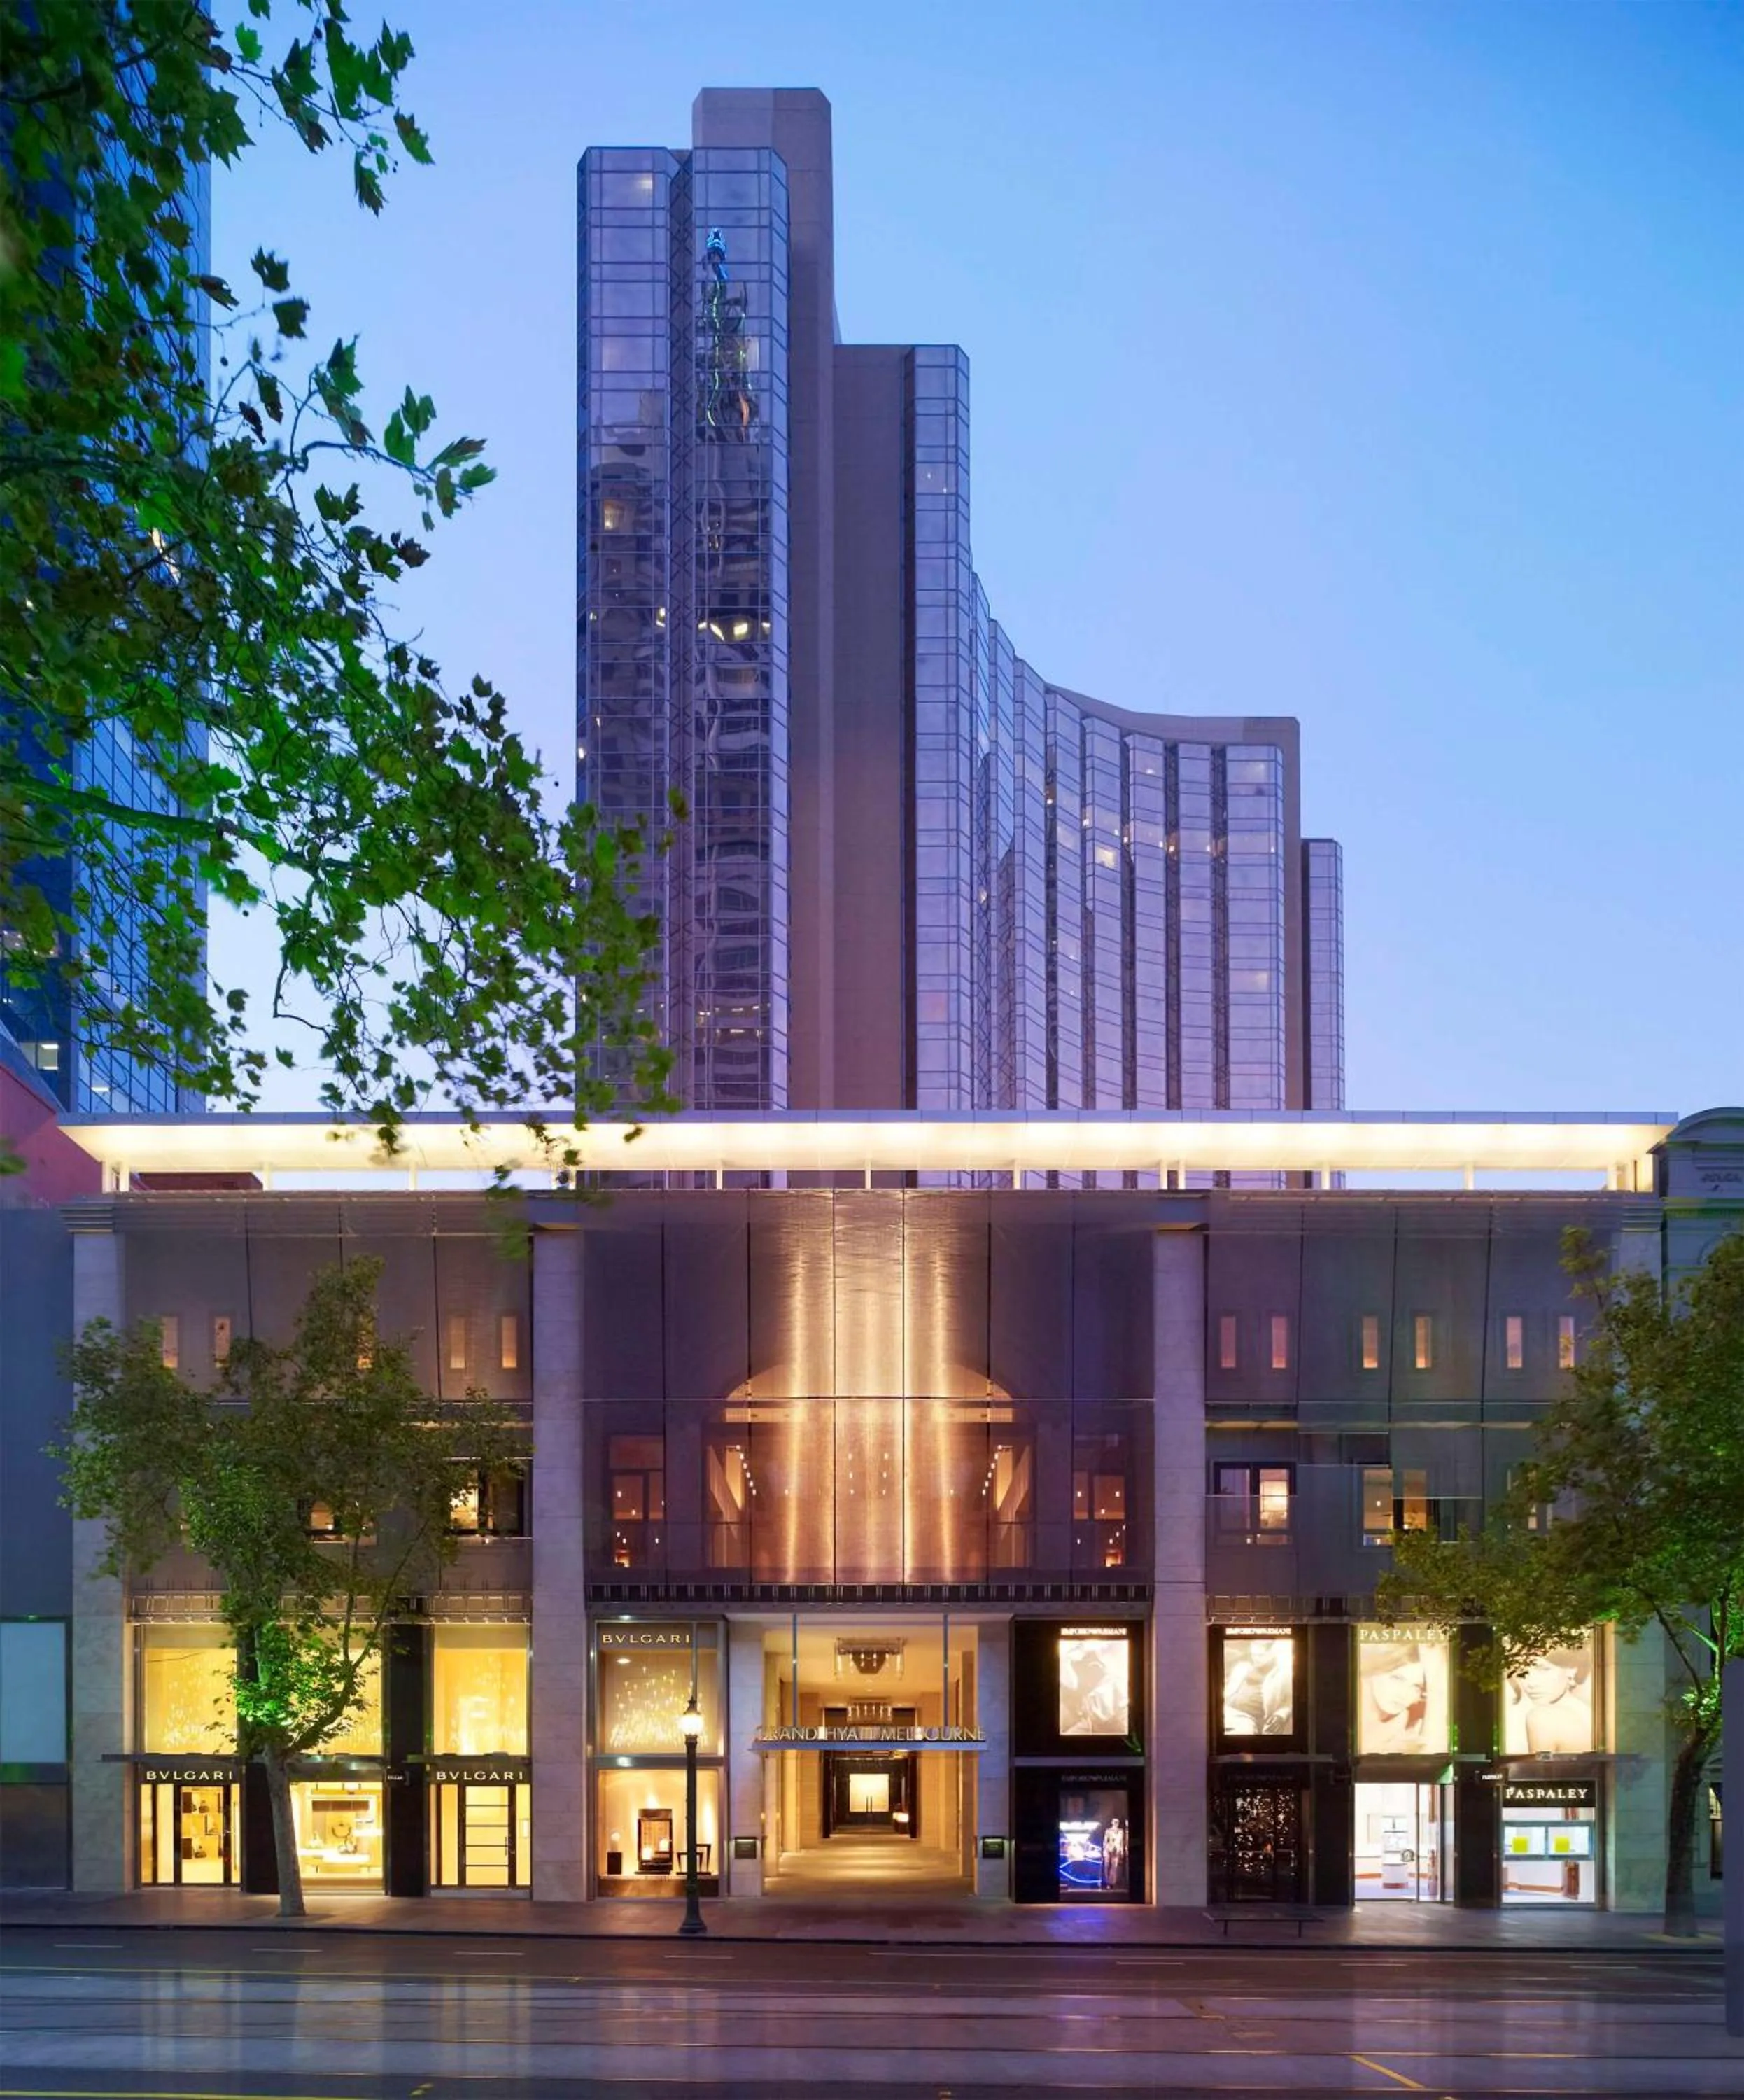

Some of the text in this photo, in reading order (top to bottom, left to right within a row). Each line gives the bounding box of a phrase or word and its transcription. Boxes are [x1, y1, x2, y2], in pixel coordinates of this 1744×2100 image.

[602, 1634, 690, 1644] BVLGARI
[1359, 1629, 1447, 1641] PASPALEY
[825, 1726, 878, 1740] HYATT
[880, 1726, 986, 1741] MELBOURNE
[146, 1770, 232, 1780] BVLGARI
[436, 1771, 523, 1780] BVLGARI
[1505, 1787, 1588, 1799] PASPALEY
